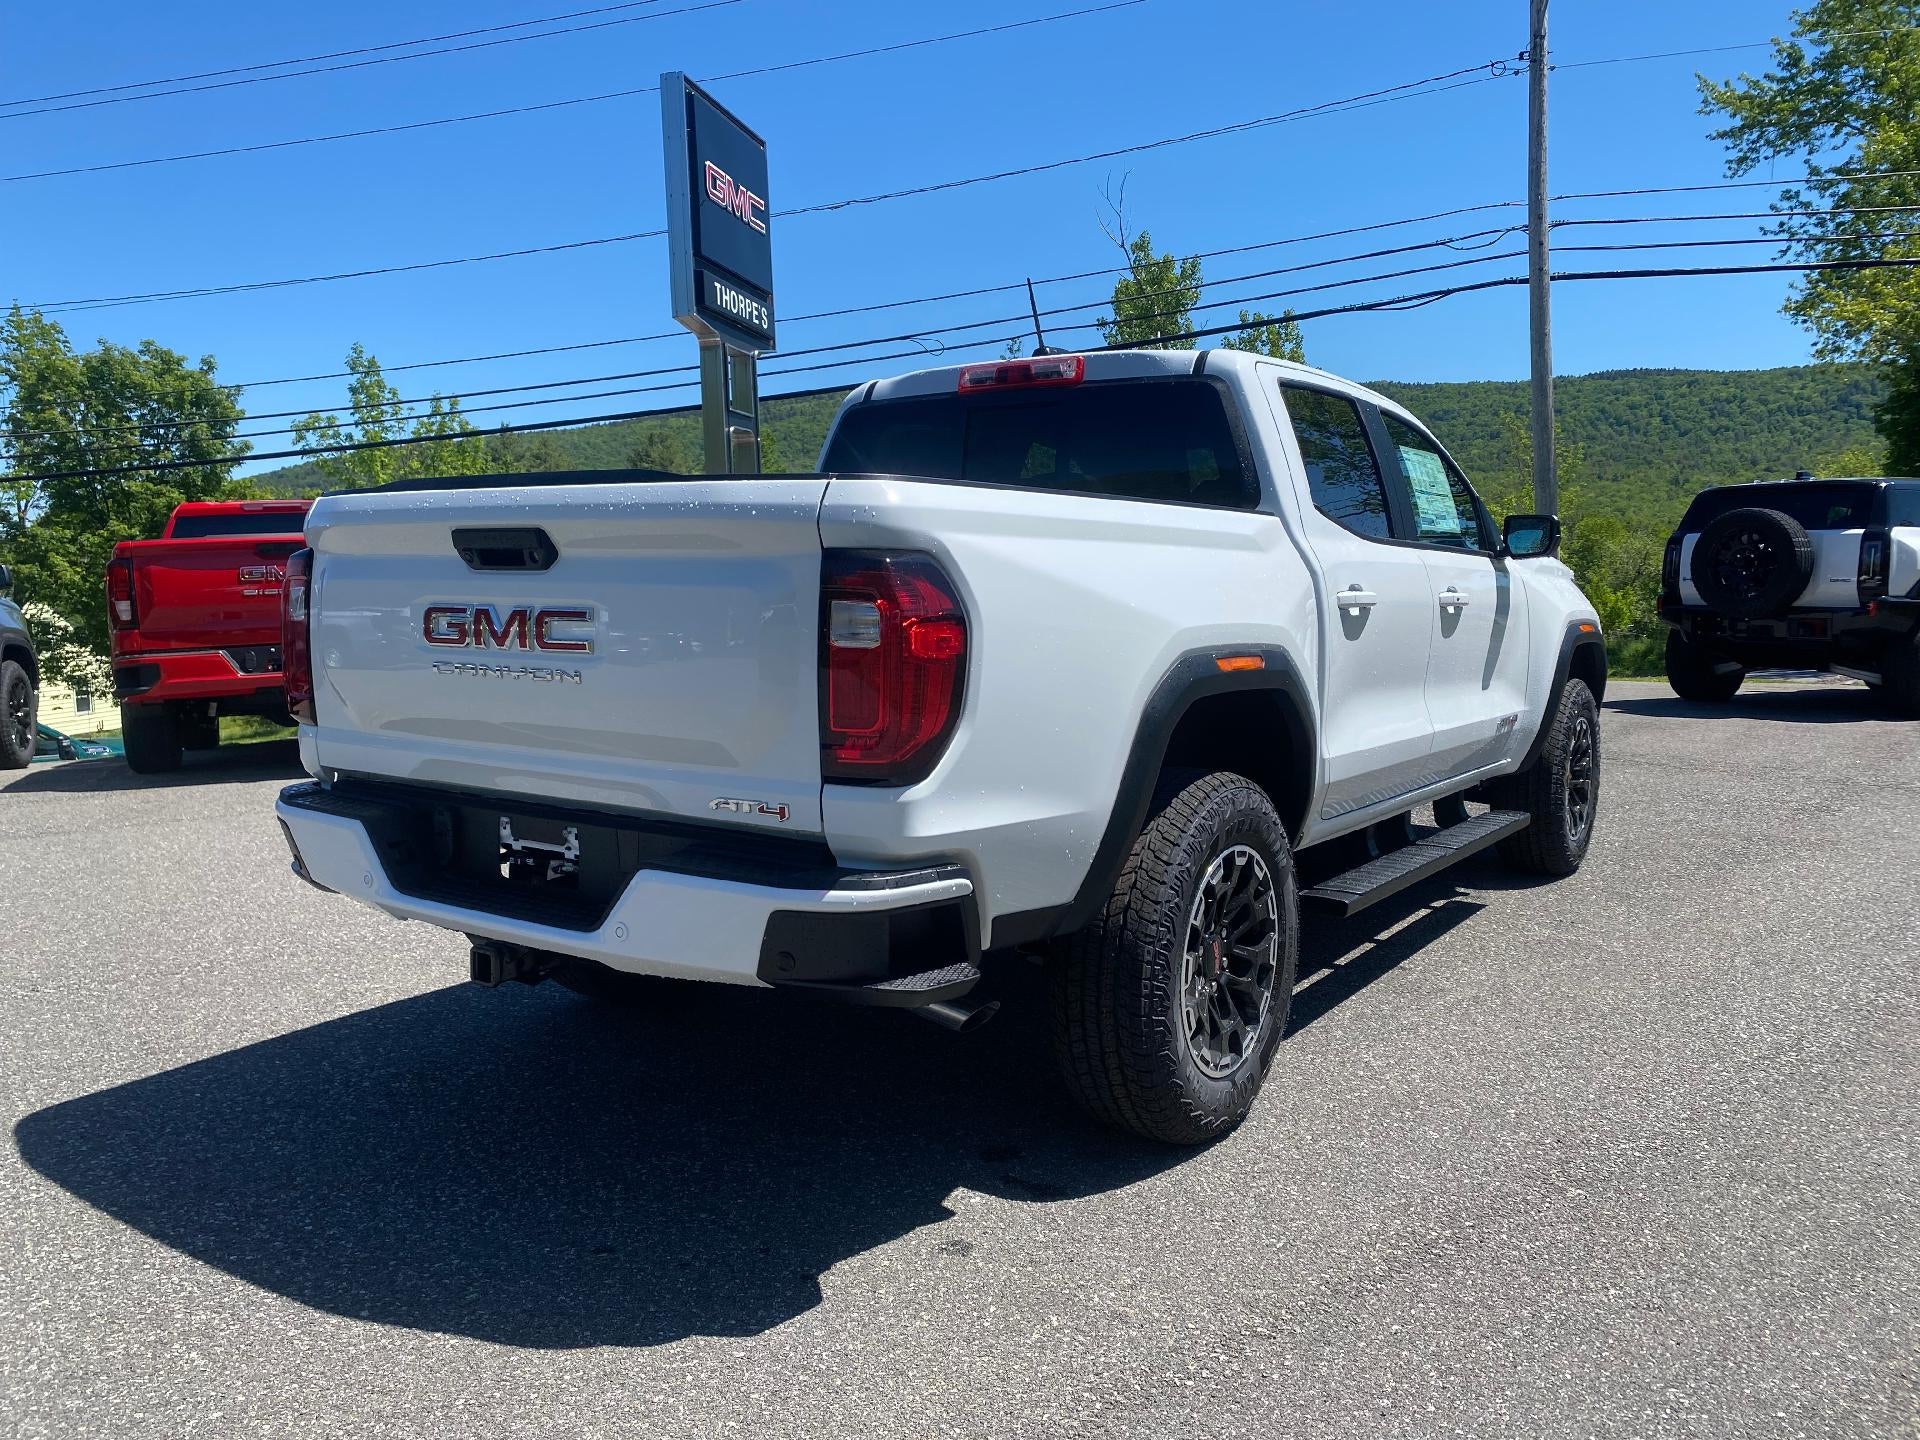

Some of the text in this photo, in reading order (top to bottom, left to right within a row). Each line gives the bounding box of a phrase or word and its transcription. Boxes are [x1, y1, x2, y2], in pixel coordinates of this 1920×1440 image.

[705, 161, 767, 235] GMC
[713, 281, 769, 330] THORPE'S
[423, 602, 595, 655] GMC
[432, 660, 583, 685] CANYON
[709, 797, 790, 822] AT4
